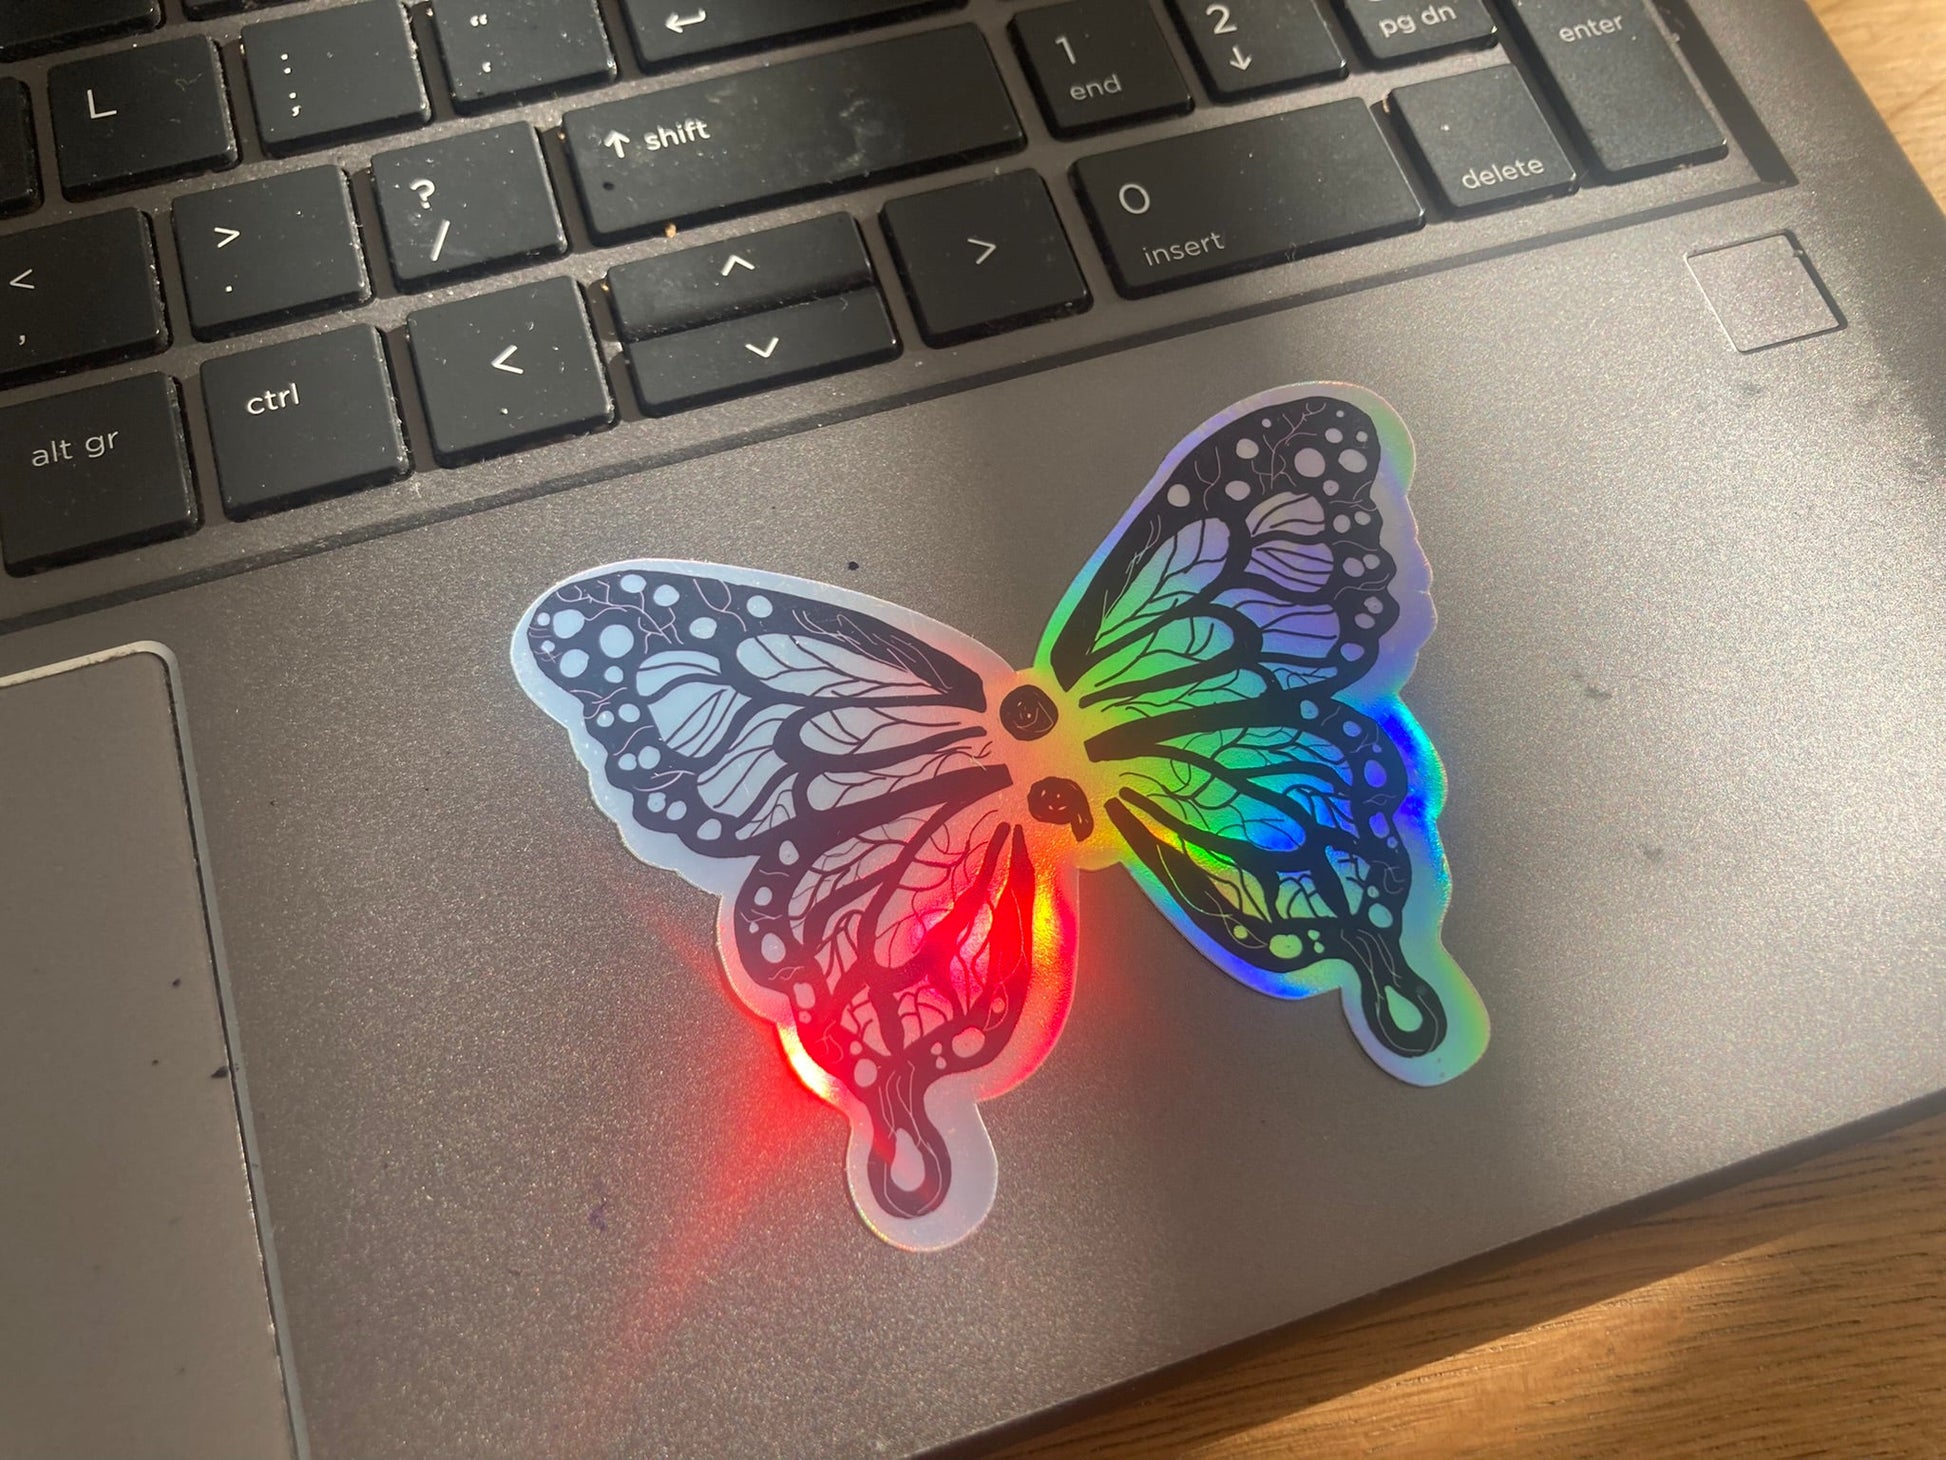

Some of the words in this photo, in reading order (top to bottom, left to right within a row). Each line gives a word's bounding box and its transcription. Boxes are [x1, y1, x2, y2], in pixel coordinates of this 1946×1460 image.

[1206, 4, 1238, 34] 2
[1378, 14, 1417, 38] pg
[1420, 5, 1457, 25] dn
[1559, 12, 1624, 43] enter
[1055, 36, 1077, 65] 1
[1069, 73, 1122, 101] end
[86, 89, 118, 119] L
[644, 118, 711, 151] shift
[1461, 155, 1545, 190] delete
[410, 179, 435, 209] ?
[1144, 231, 1225, 266] insert
[246, 382, 300, 416] ctrl
[31, 439, 73, 467] alt
[85, 430, 119, 458] gr
